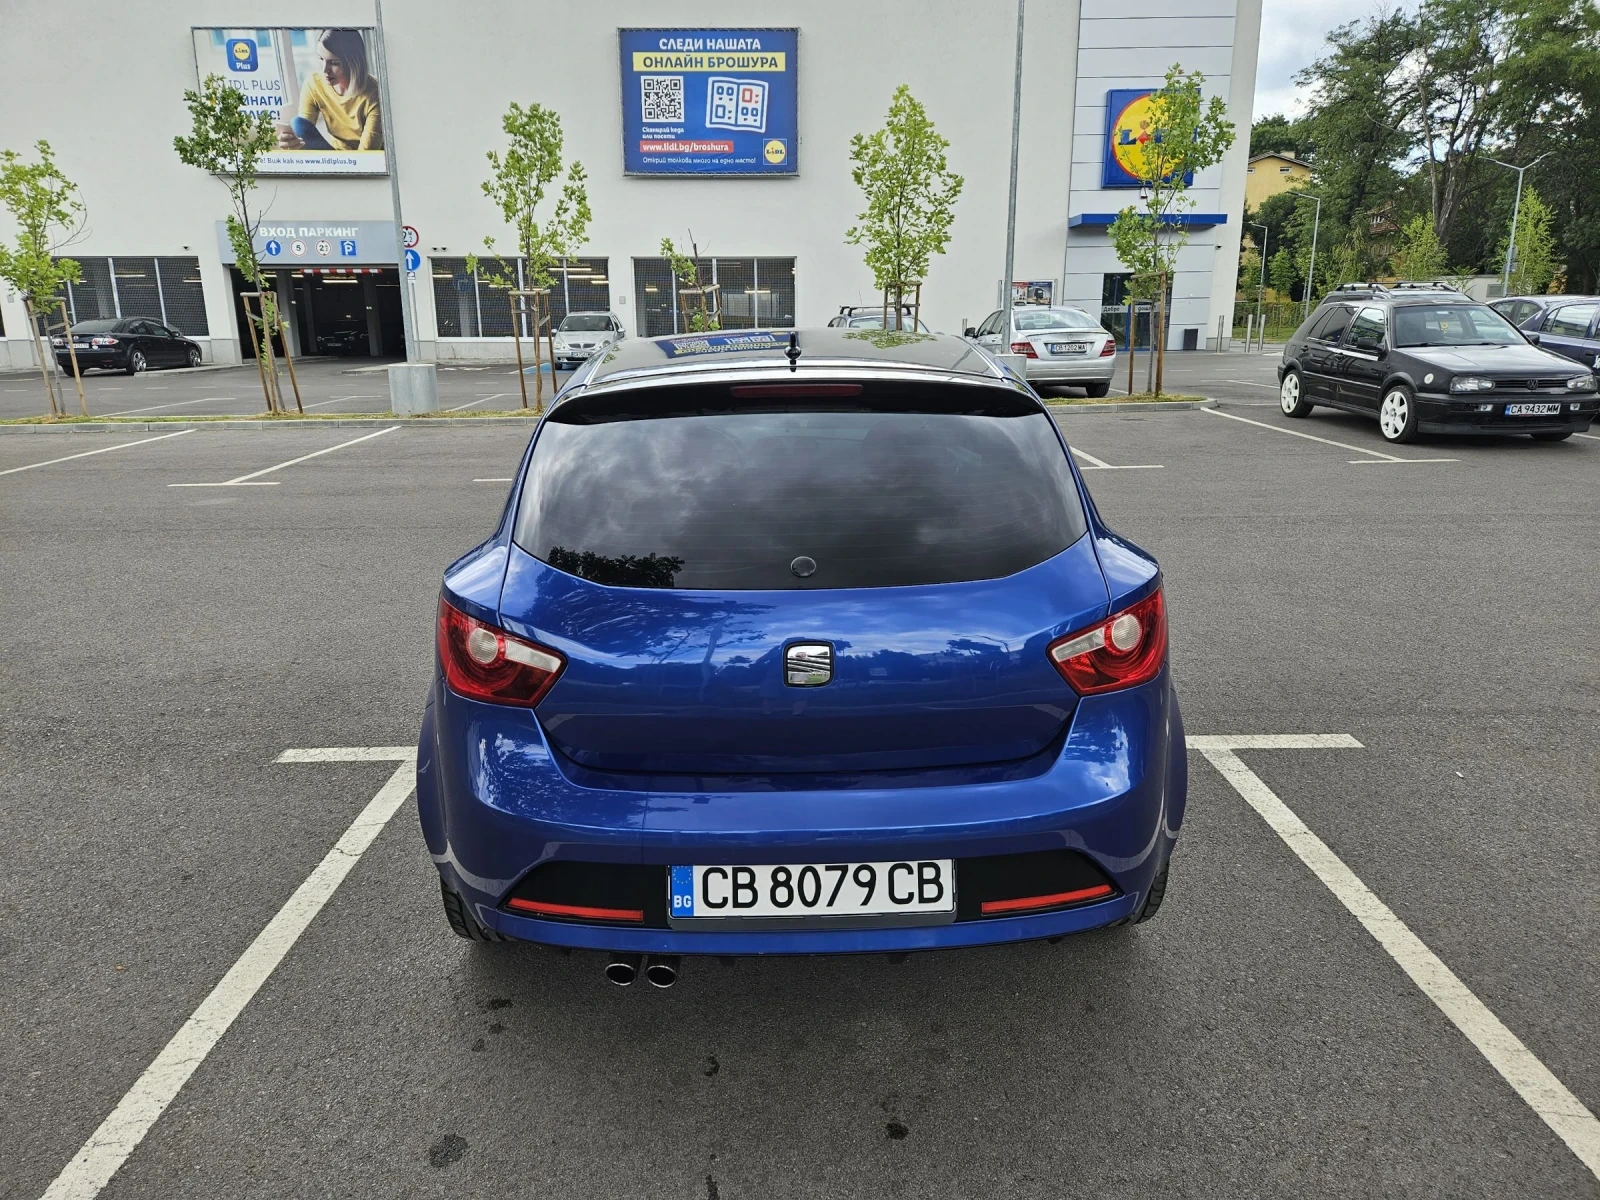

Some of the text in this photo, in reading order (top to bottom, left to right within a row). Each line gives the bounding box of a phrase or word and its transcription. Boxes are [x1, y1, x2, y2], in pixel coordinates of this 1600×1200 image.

[659, 38, 761, 51] СЛЕДИ НАШАТА
[236, 62, 251, 70] Plus
[643, 54, 778, 68] ОНЛАЙН БРОШУРА
[251, 79, 281, 91] PLUS
[642, 142, 729, 152] www.lidl.bg/broshura
[305, 157, 357, 165] www.lidlplus.bg
[259, 227, 359, 238] ВХОД ПАРКИНГ
[1510, 404, 1560, 414] CA 9432 MM
[702, 862, 944, 909] CB 8079 CB
[673, 895, 692, 908] BG
